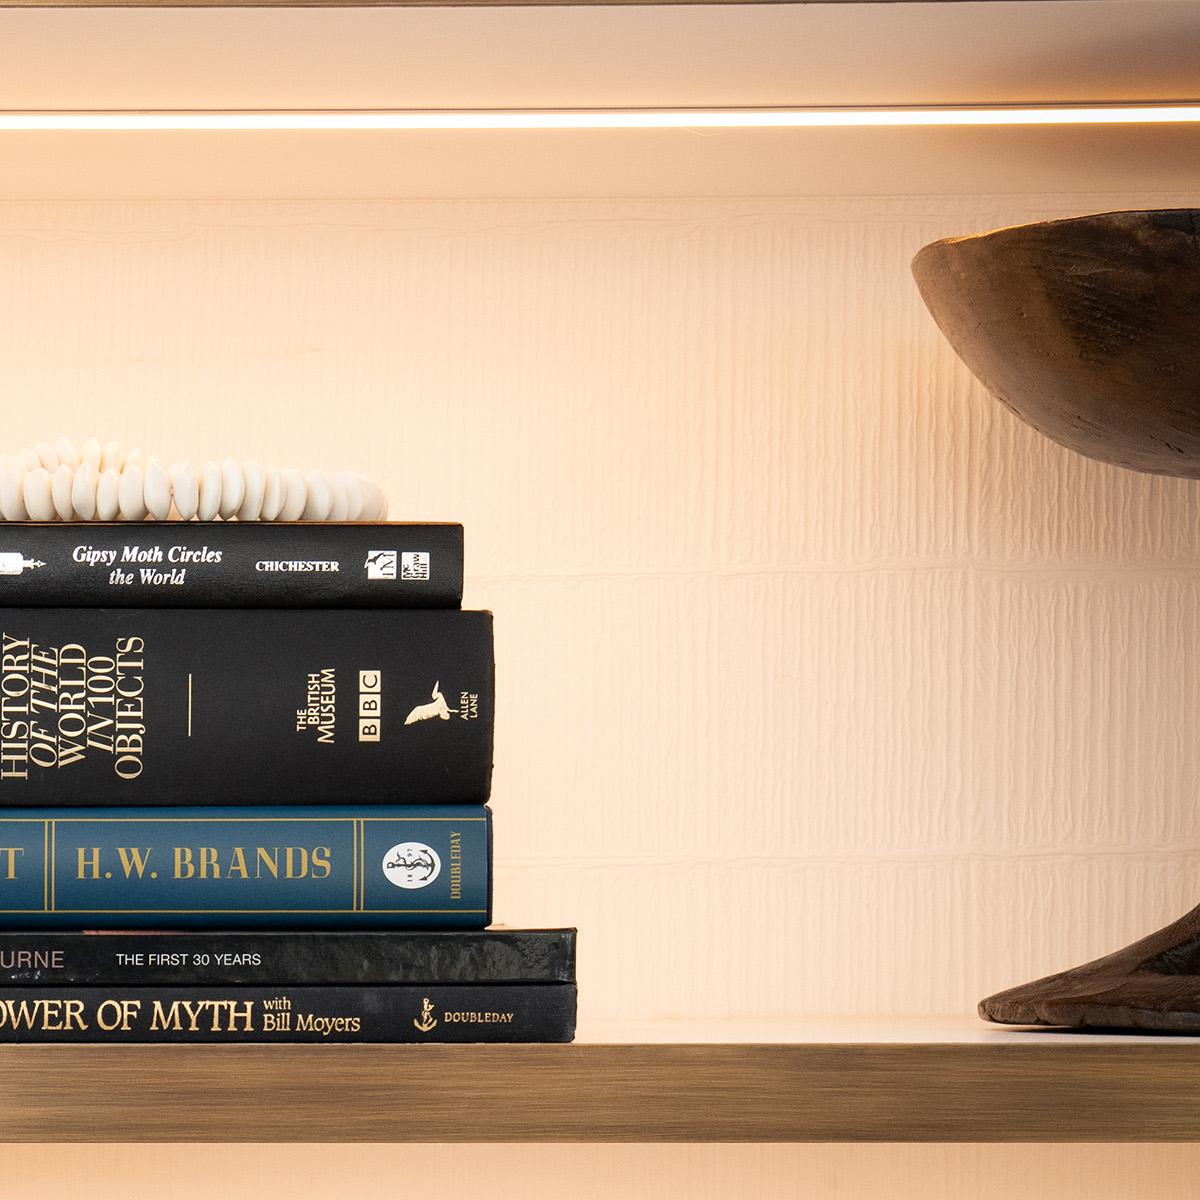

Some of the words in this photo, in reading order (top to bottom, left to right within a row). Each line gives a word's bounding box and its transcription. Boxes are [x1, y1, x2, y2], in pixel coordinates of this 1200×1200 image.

[72, 545, 117, 567] Gipsy
[121, 545, 164, 563] Moth
[167, 545, 223, 564] Circles
[255, 560, 340, 572] CHICHESTER
[108, 567, 135, 585] the
[139, 568, 186, 586] World
[30, 644, 58, 714] THE
[87, 656, 115, 709] 100
[1, 632, 30, 780] HISTORY
[58, 643, 86, 769] WORLD
[114, 636, 146, 780] OBJECTS
[307, 673, 320, 725] BRITISH
[317, 668, 336, 744] MUSEUM
[358, 670, 381, 742] BBC
[460, 691, 469, 721] ALLEN
[469, 693, 478, 718] LANE
[87, 711, 114, 754] IN
[296, 708, 307, 732] THE
[29, 720, 57, 768] OF
[75, 847, 158, 880] H.W.
[172, 846, 332, 880] BRANDS
[449, 831, 462, 899] DOUBLEDAY
[116, 953, 144, 966] THE
[148, 953, 188, 966] FIRST
[193, 953, 210, 966] 30
[214, 953, 262, 966] YEARS
[96, 999, 142, 1031] OF
[149, 1000, 255, 1032] MYTH
[263, 996, 292, 1010] with
[444, 1011, 514, 1024] DOUBLEDAY
[263, 1011, 291, 1032] Bill
[295, 1013, 361, 1036] Moyers
